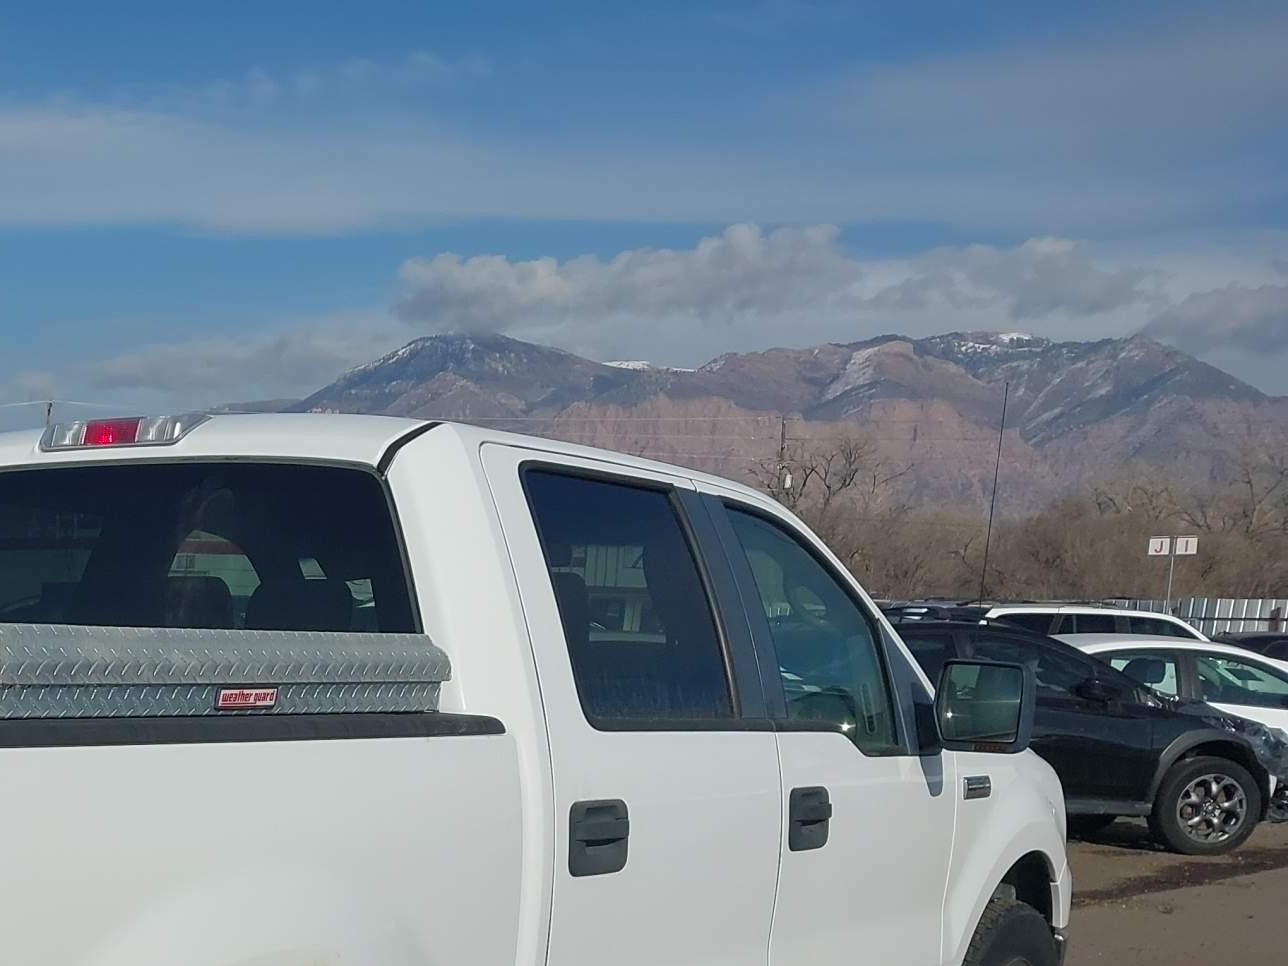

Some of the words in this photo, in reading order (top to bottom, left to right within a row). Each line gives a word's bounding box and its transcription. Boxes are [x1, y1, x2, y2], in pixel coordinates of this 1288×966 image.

[1154, 540, 1164, 553] J
[221, 690, 253, 702] weather
[253, 690, 276, 702] guard
